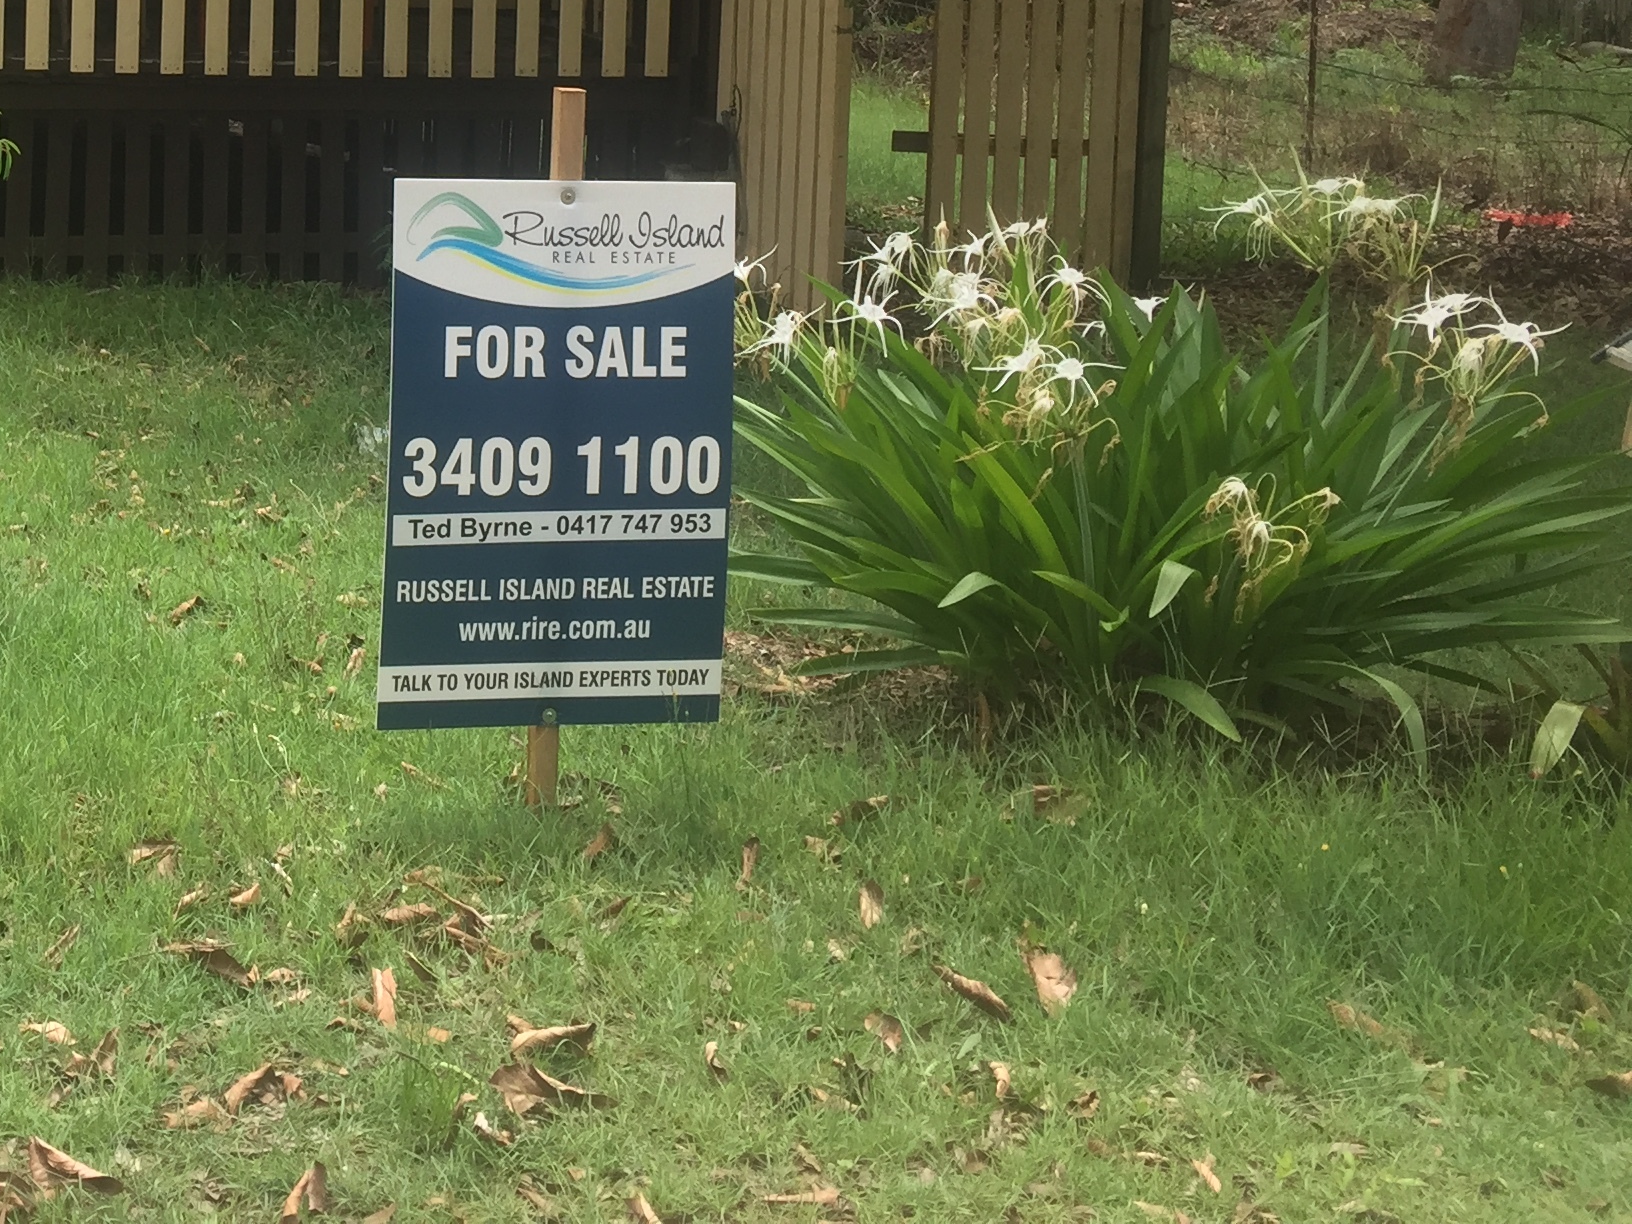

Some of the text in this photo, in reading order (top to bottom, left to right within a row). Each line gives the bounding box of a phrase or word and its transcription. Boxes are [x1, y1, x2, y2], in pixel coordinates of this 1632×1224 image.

[502, 210, 726, 249] Russell Island
[552, 250, 677, 265] REAL ESTATE
[444, 324, 688, 379] FOR SALE
[402, 435, 721, 497] 3409 1100
[408, 517, 452, 539] Ted
[460, 517, 533, 542] Byrne
[556, 514, 613, 536] 0417
[621, 513, 663, 535] 747
[670, 513, 712, 534] 953
[396, 576, 715, 603] RUSSELL ISLAND REAL ESTATE
[458, 616, 651, 642] www.rire.com.au
[392, 669, 710, 692] TALK TO YOUR ISLAND EXPERTS TODAY
